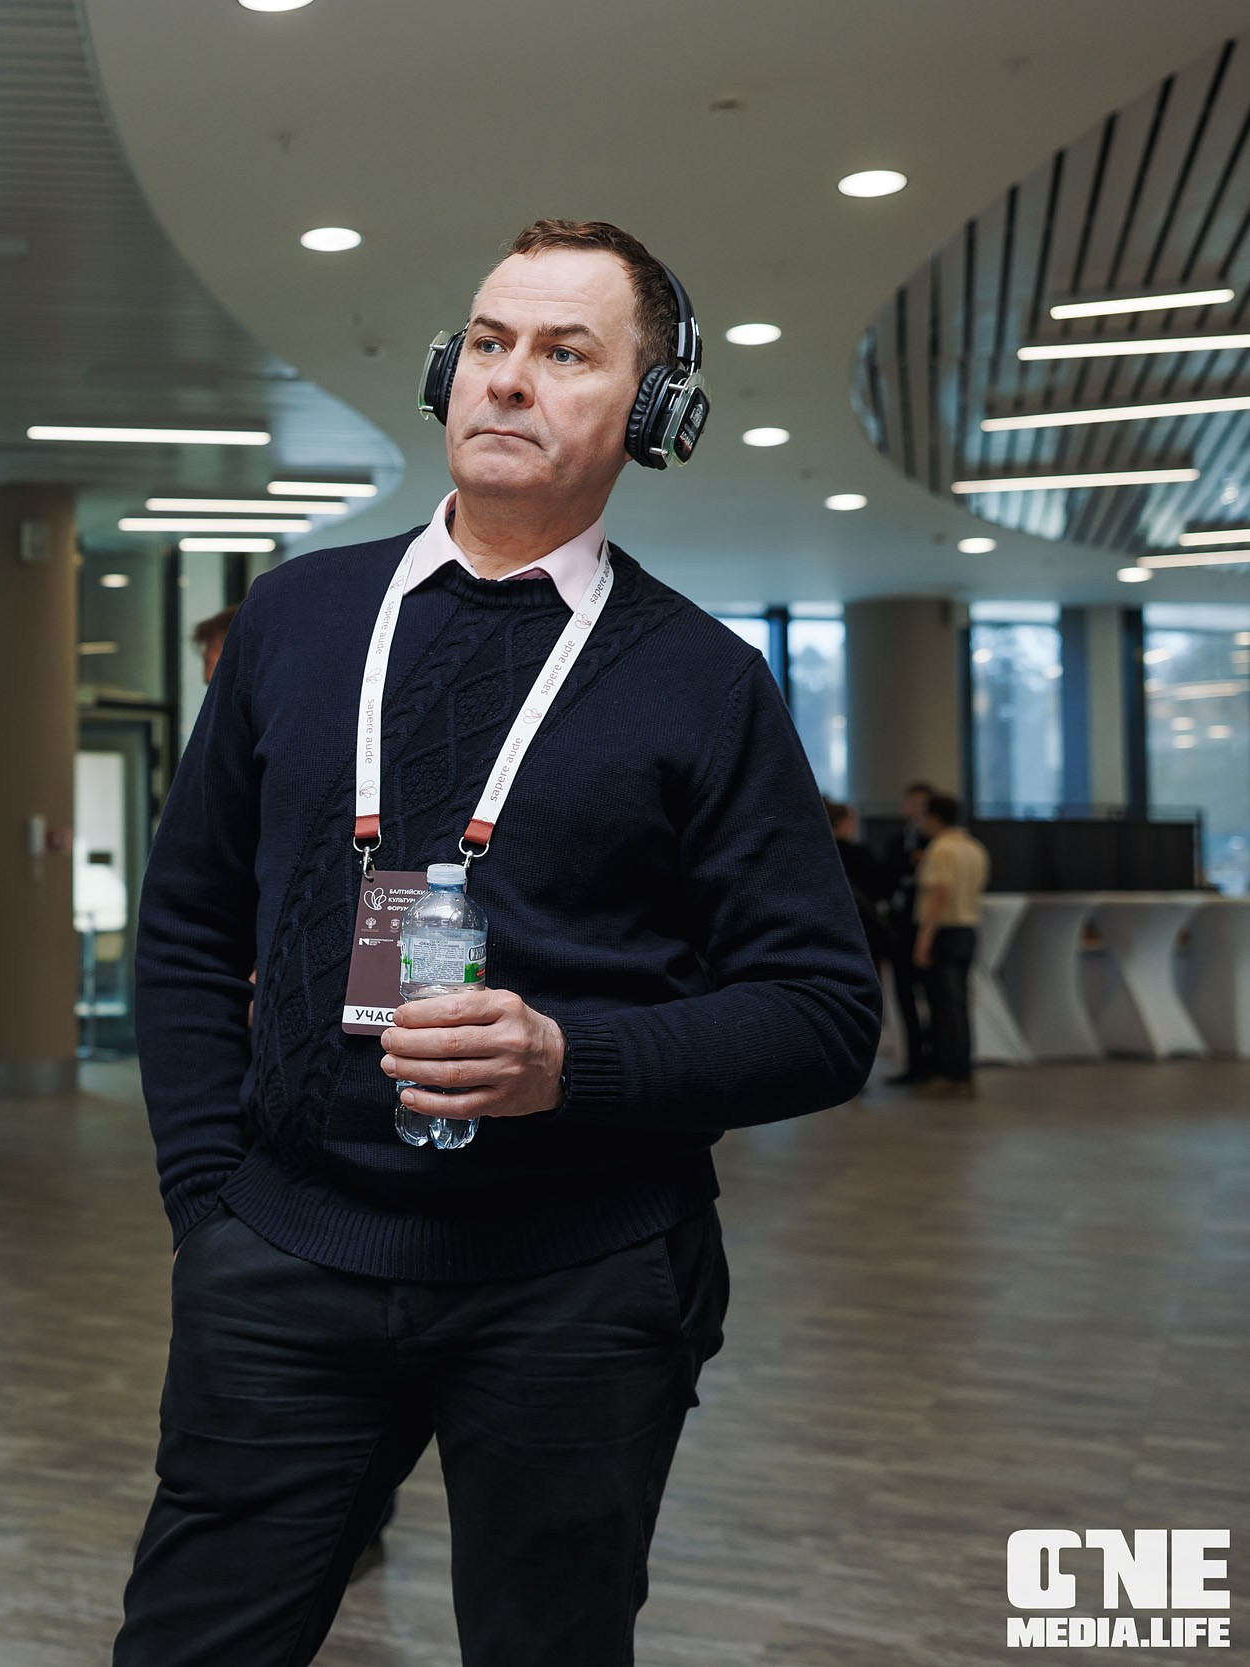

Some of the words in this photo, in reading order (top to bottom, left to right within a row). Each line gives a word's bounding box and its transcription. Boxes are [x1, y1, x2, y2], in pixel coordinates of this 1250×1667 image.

[589, 576, 607, 604] sapere
[381, 600, 395, 631] sapere
[375, 631, 387, 655] aude
[541, 661, 564, 696] sapere
[557, 639, 576, 663] aude
[365, 698, 375, 735] sapere
[364, 736, 374, 764] aude
[490, 761, 512, 802] sapere
[507, 736, 524, 763] aude
